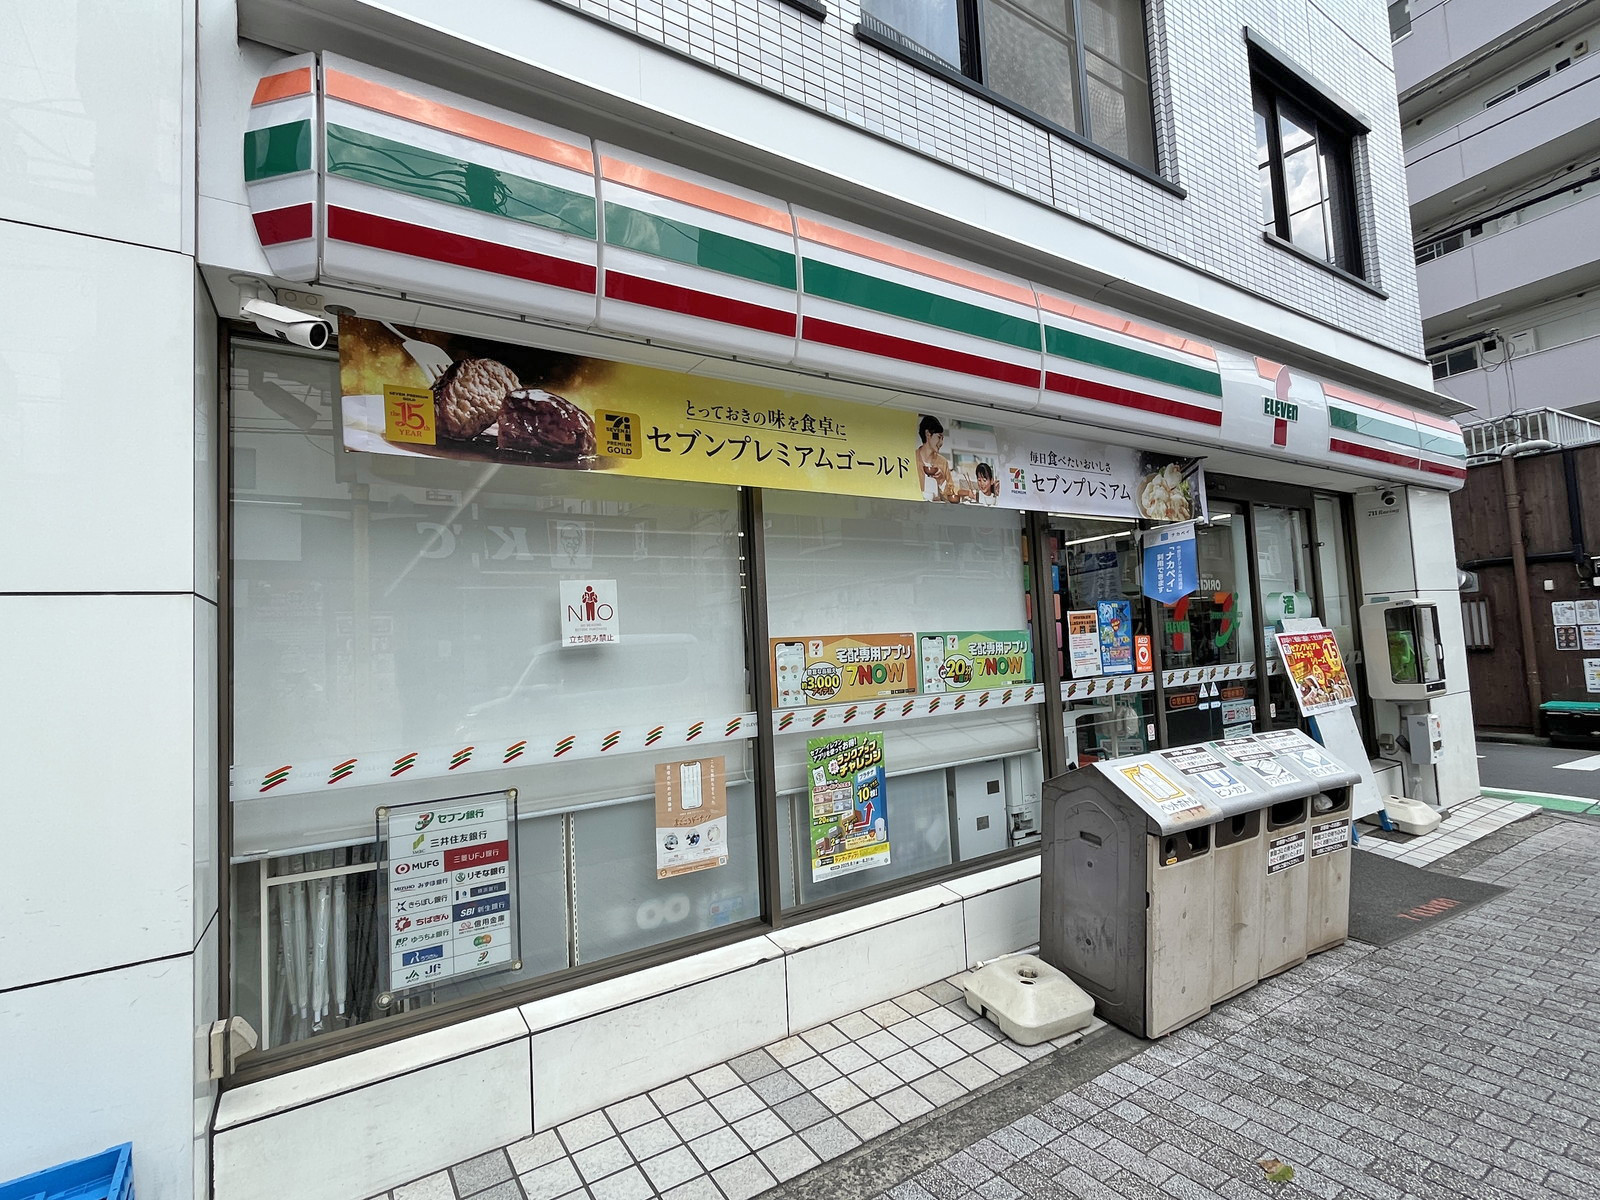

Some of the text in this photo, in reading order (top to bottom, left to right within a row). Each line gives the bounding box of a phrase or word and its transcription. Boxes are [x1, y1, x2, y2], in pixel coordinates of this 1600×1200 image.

[392, 401, 424, 430] 15
[687, 400, 847, 436] とっておきの味を食卓に
[399, 428, 422, 438] YEAR
[607, 446, 632, 455] GOLD
[647, 426, 911, 479] セブンプレミアムゴールド
[1030, 450, 1111, 473] 毎日食べたいおいしさ
[1032, 473, 1131, 500] セブンプレミアム
[1156, 553, 1164, 594] 利用できます
[1166, 546, 1176, 593] 「ナカペイ」
[1283, 596, 1295, 614] 酒
[569, 633, 614, 643] 立ち読み禁止
[836, 644, 911, 663] 宅配専用アプリ
[968, 640, 1028, 656] 宅配専用アプリ
[976, 656, 1022, 676] 7NOW
[846, 662, 905, 686] 7NOW
[812, 687, 834, 696] アイテム
[837, 739, 877, 765] ランクアップ
[840, 748, 881, 777] チャレンジ
[859, 769, 874, 780] プラチナ
[1161, 797, 1197, 811] ペットボトル
[438, 809, 484, 824] セブン銀行
[430, 830, 487, 848] 三井住友銀行
[454, 849, 499, 863] 三菱UFJ銀行
[412, 860, 439, 871] MUFG
[468, 866, 505, 880] りそな銀行
[418, 878, 448, 889] みずほ銀行
[408, 895, 448, 909] きらぼし銀行
[460, 902, 505, 917] SBI 新生銀行
[416, 914, 449, 926] ちばぎん
[474, 915, 505, 928] 信用金庫
[411, 929, 449, 943] ゆうちょ銀行
